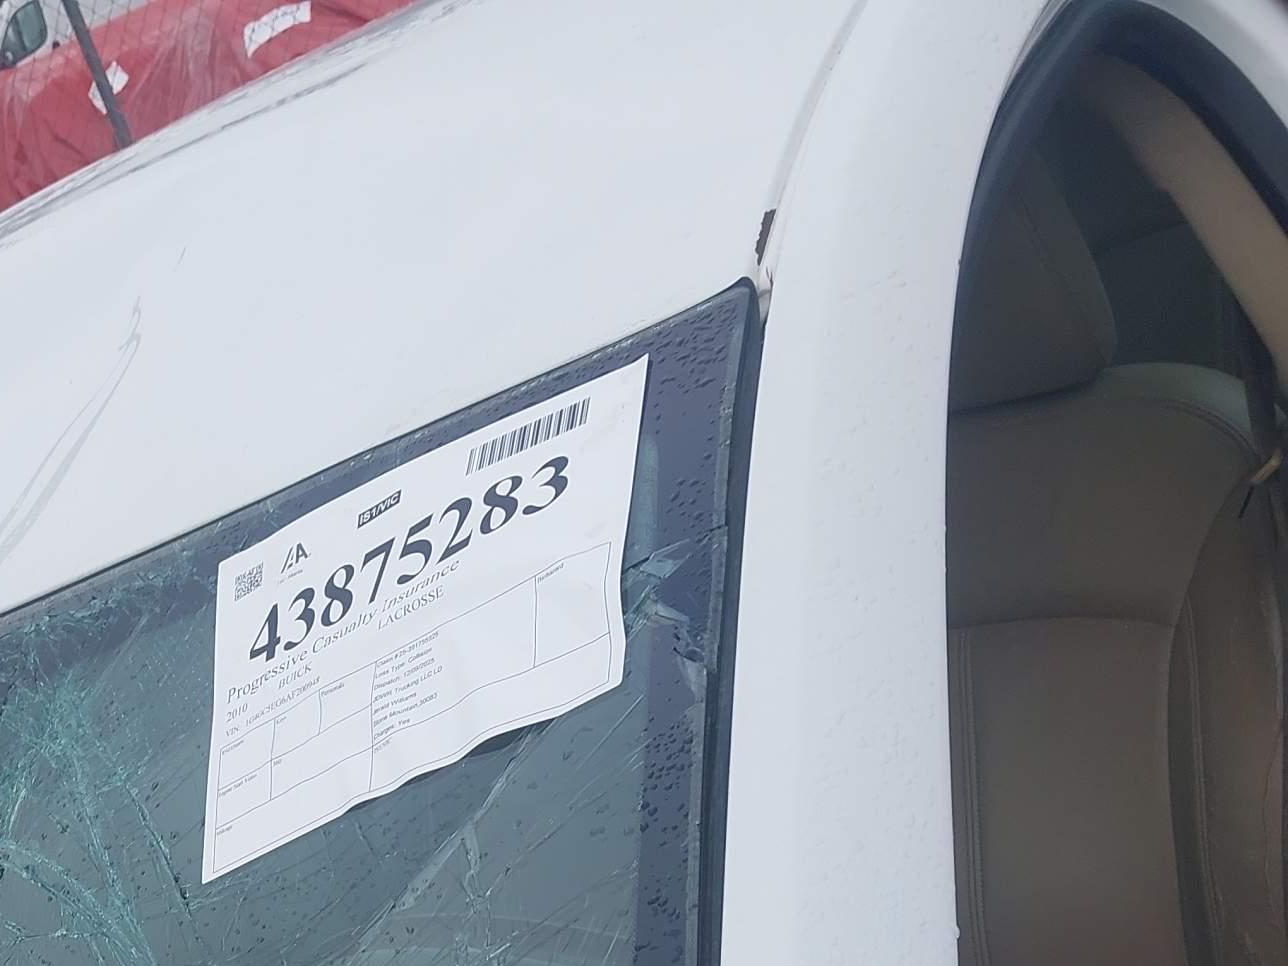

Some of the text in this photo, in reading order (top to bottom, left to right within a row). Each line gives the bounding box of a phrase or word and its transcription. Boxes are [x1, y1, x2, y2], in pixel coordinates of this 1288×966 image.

[249, 455, 569, 662] 43875283
[226, 584, 444, 723] 2010 BUICK LACROSSE
[227, 560, 460, 703] Progressive Casualty Insurance
[395, 678, 420, 694] Trucking
[420, 670, 433, 682] LLC
